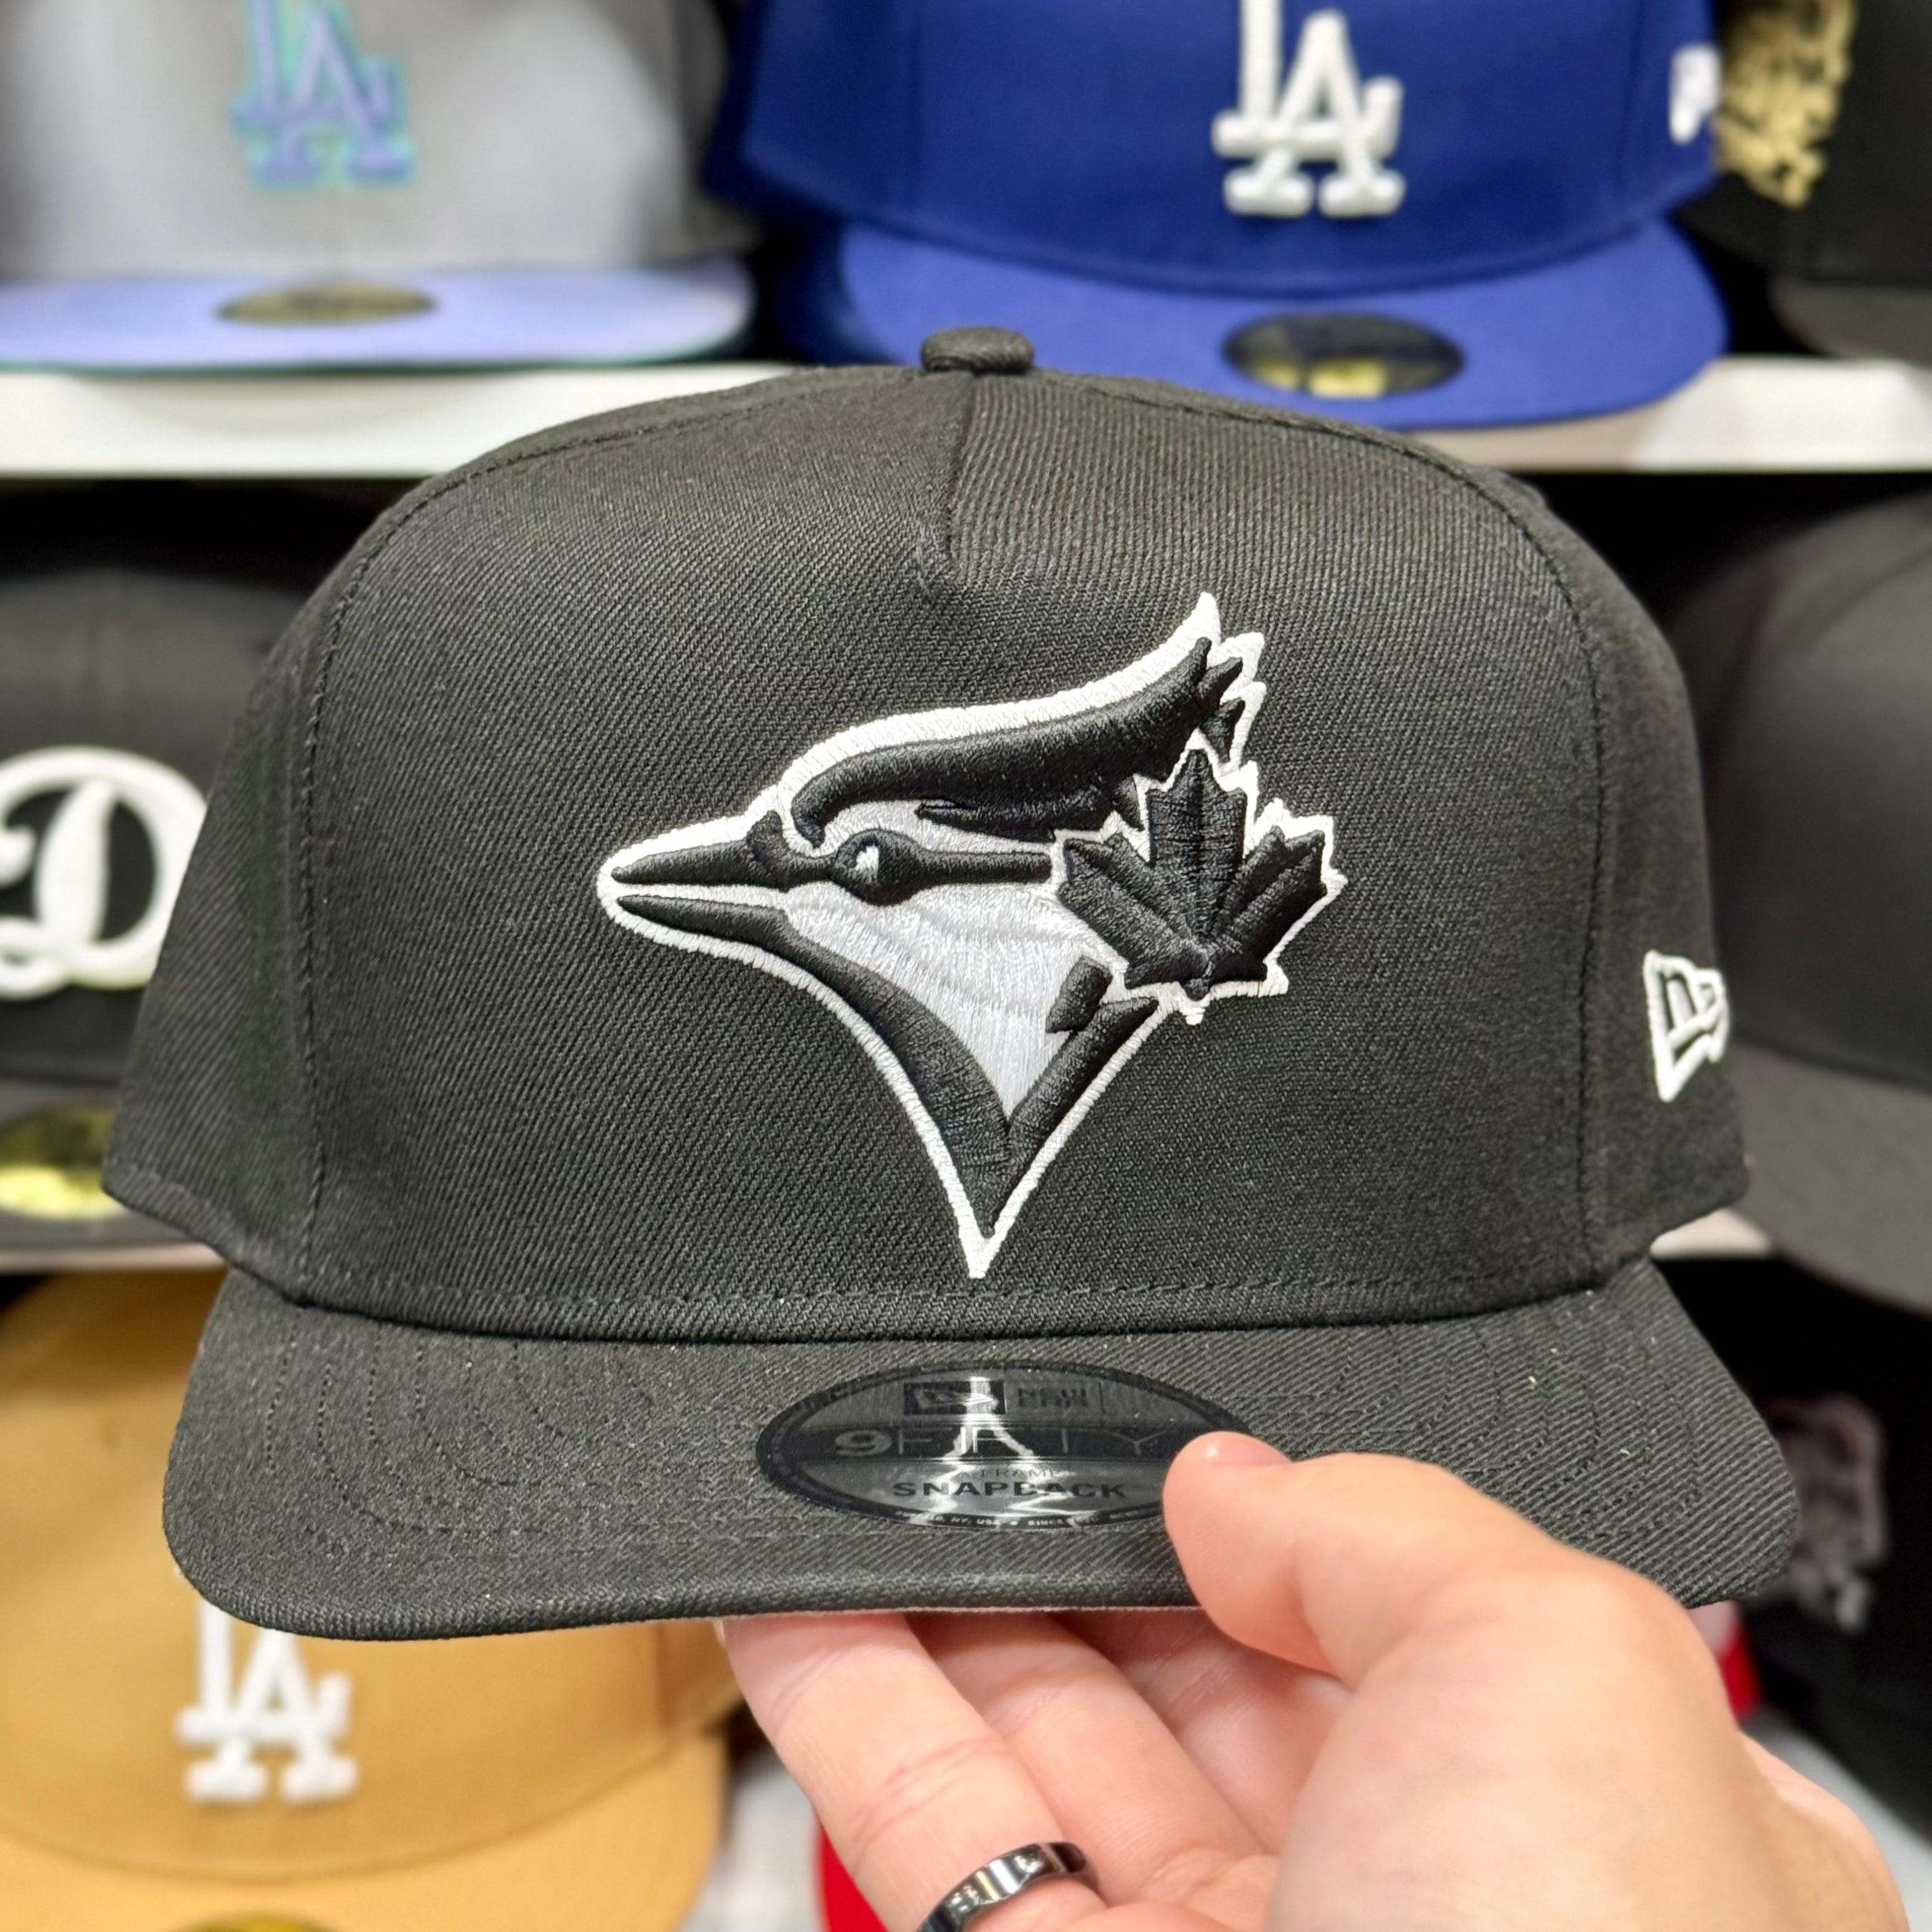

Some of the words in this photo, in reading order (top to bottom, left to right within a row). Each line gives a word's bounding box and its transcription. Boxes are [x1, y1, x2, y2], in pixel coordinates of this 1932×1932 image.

[228, 0, 414, 188] LA
[1212, 0, 1405, 218] LA
[893, 1481, 1128, 1497] SNAPBACK
[175, 1596, 361, 1804] LA
